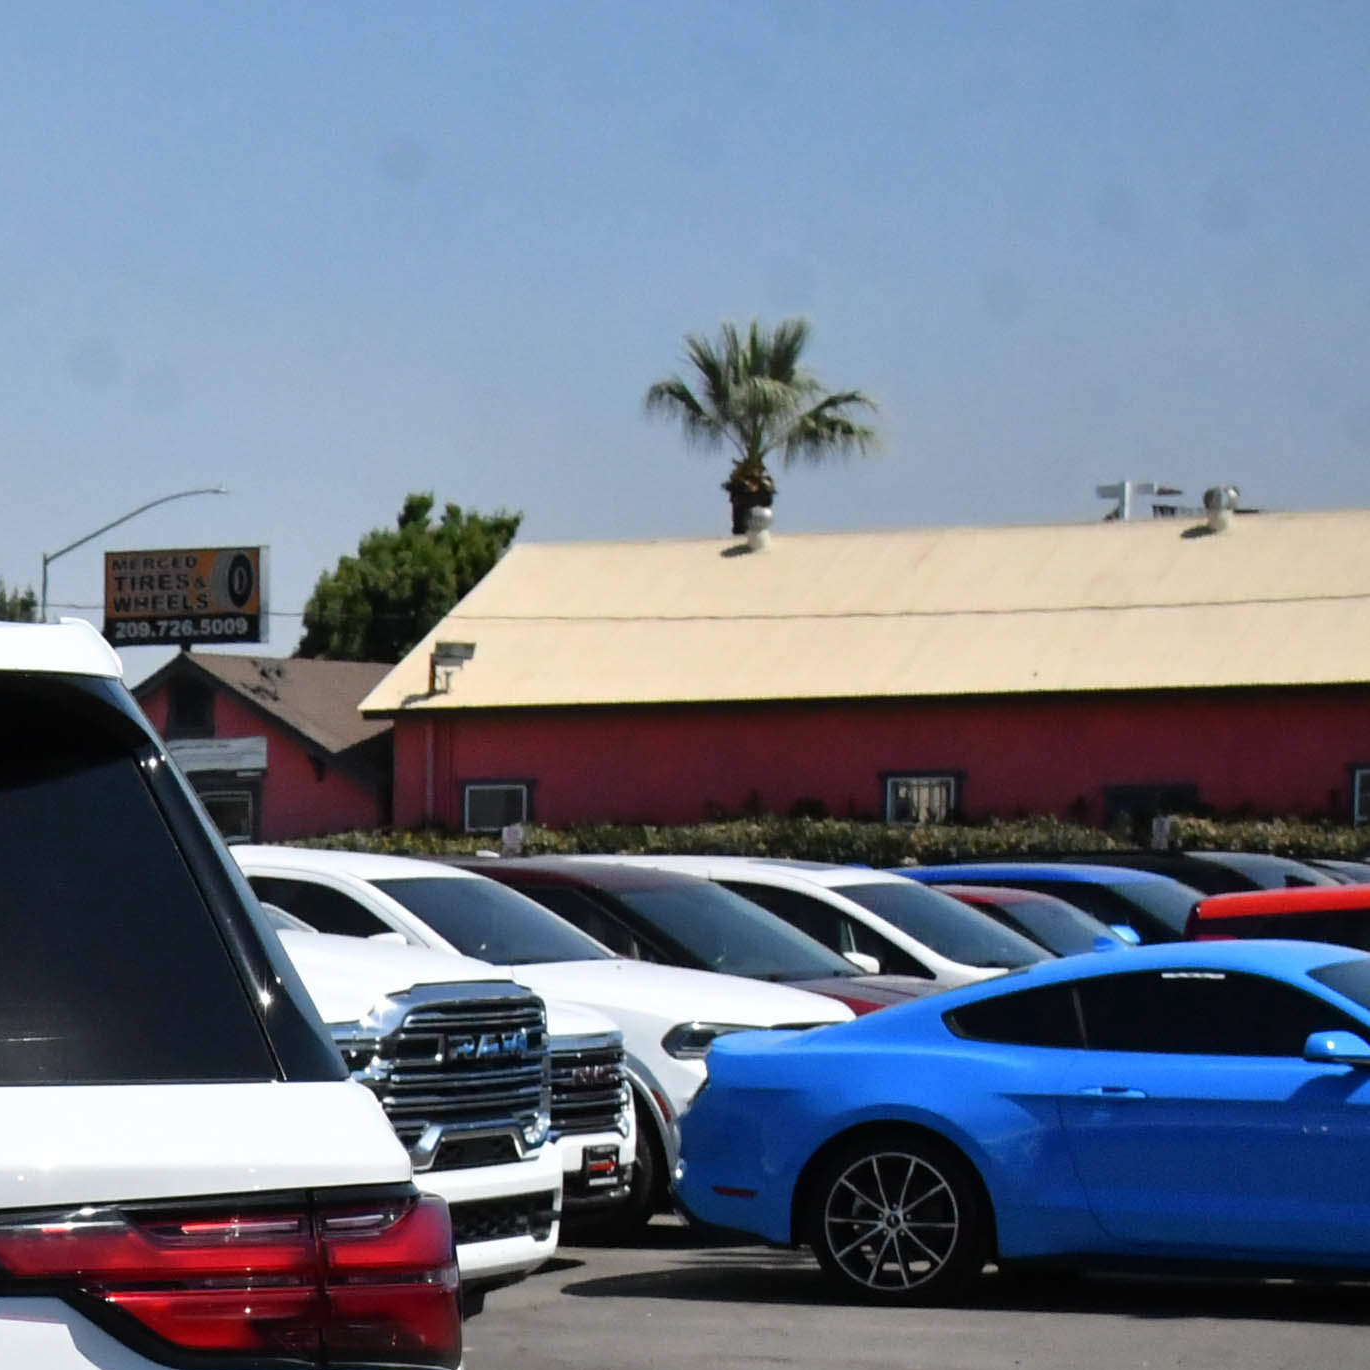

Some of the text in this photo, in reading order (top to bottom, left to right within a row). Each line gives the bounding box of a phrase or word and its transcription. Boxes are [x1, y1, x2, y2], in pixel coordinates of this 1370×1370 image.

[112, 557, 197, 570] MERCED
[114, 575, 207, 592] TIRES &
[113, 593, 209, 613] WHEELS
[115, 618, 247, 639] 209.726.5009
